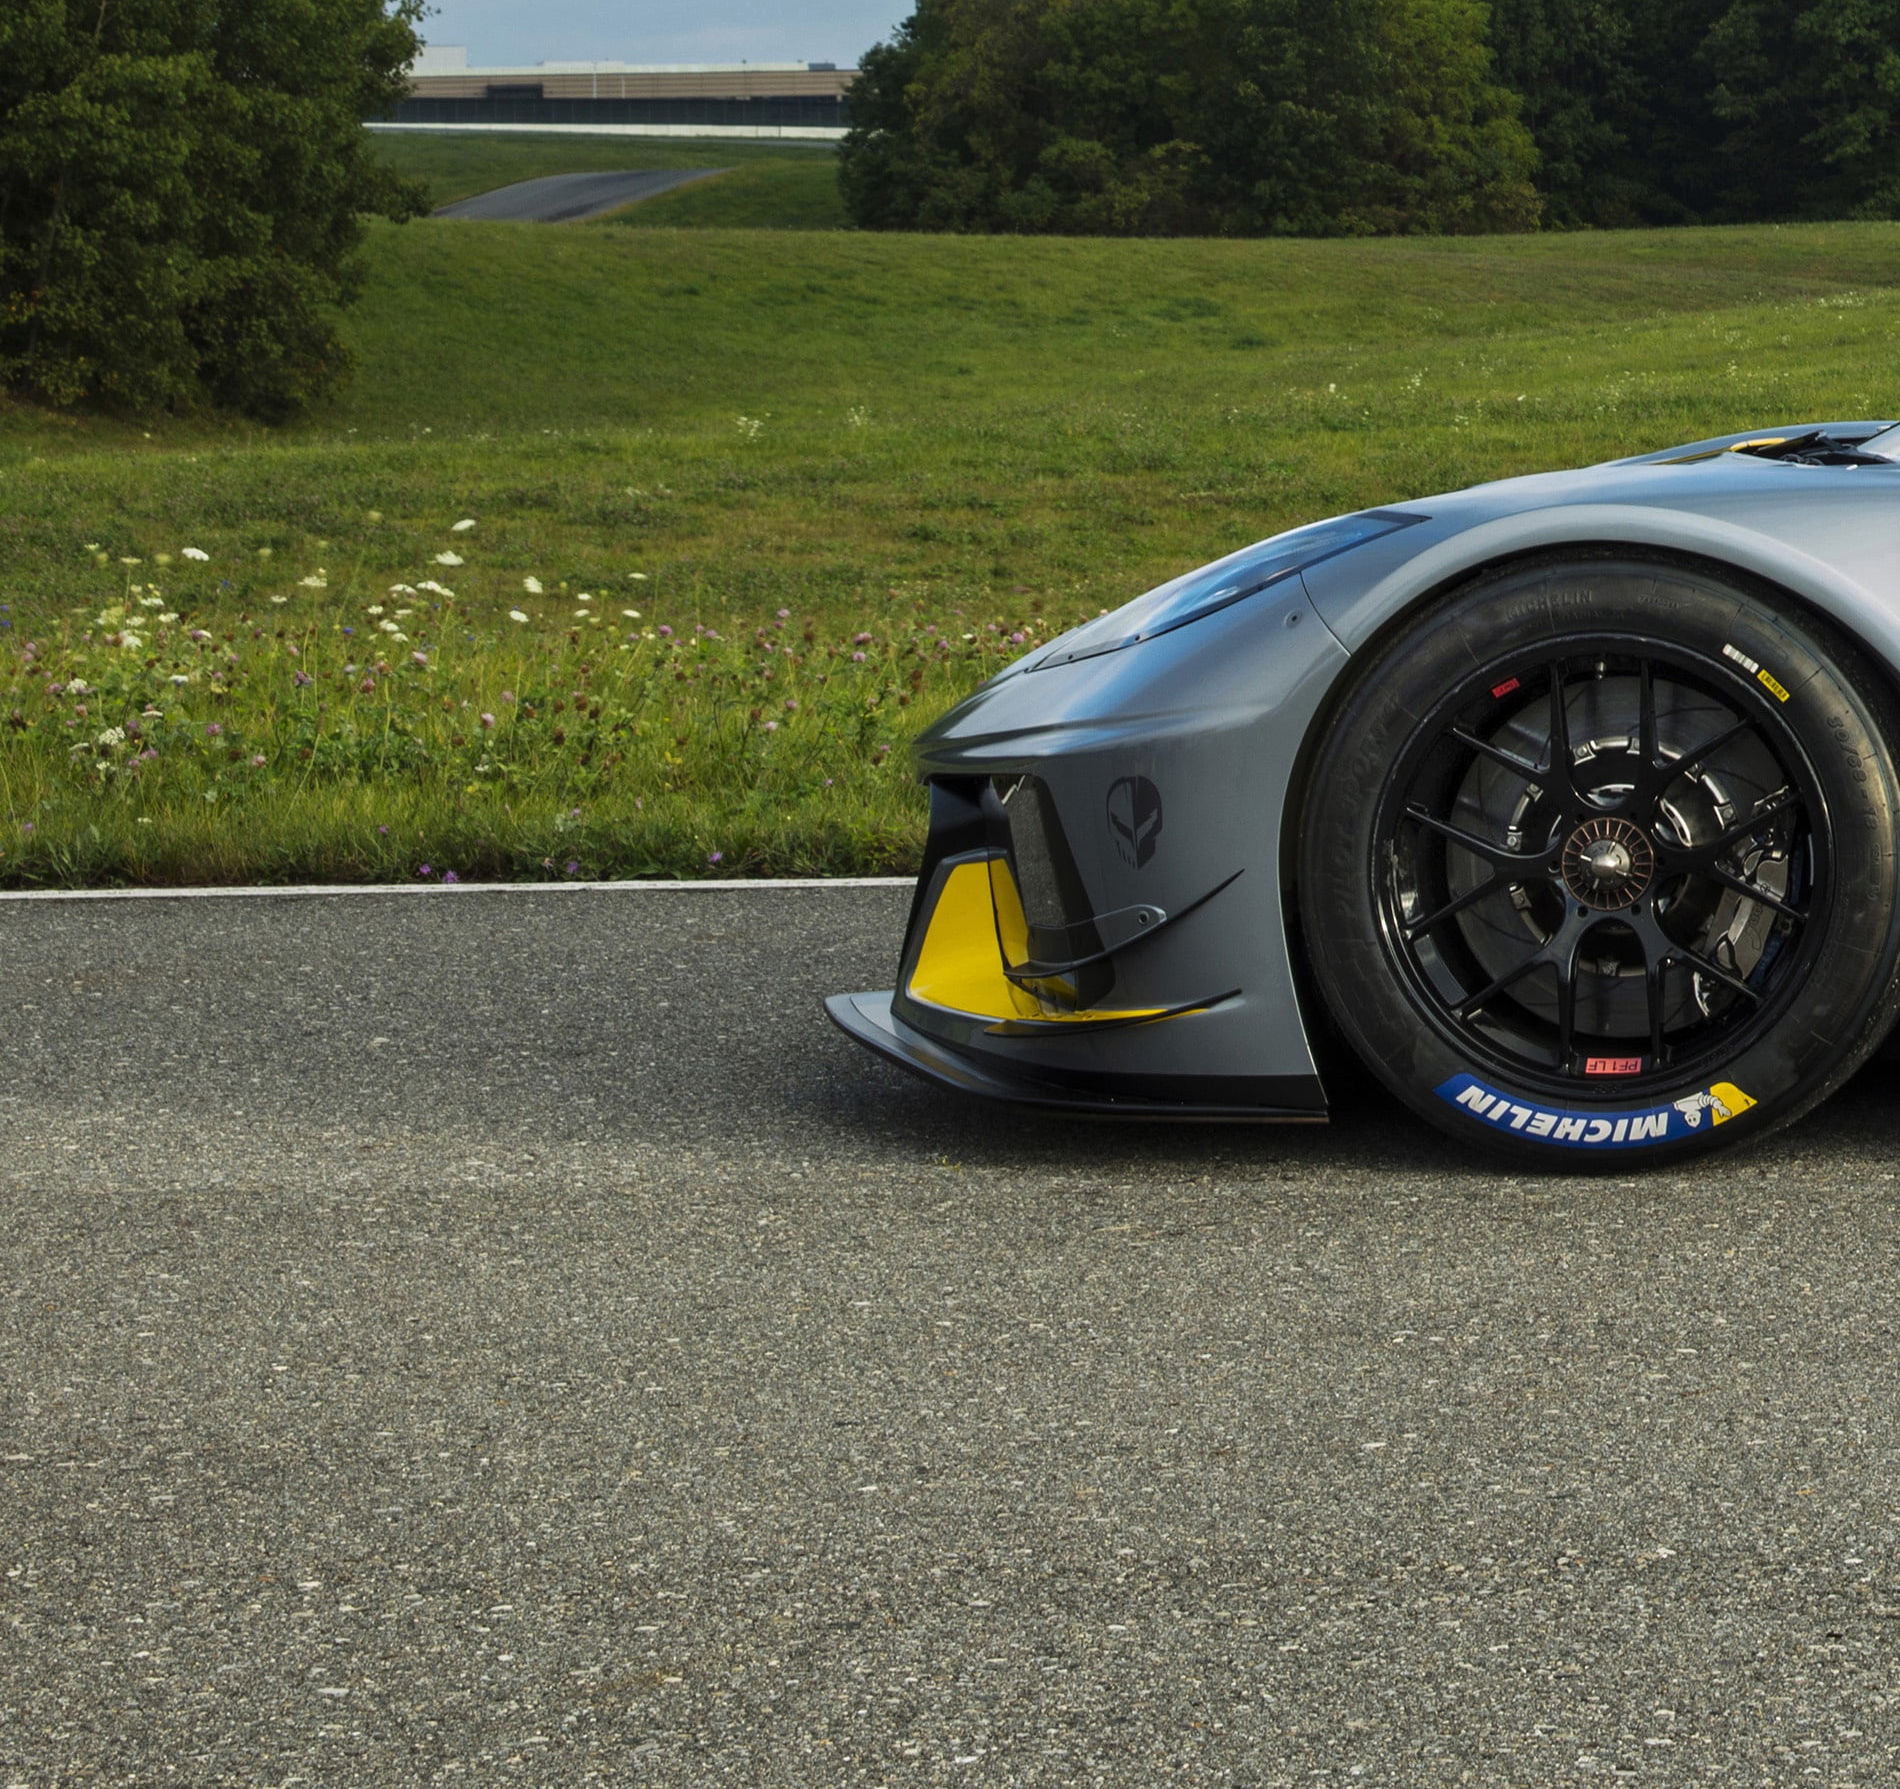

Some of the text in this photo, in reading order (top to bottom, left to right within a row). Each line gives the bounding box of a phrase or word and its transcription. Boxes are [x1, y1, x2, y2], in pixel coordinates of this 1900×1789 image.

[1588, 1060, 1638, 1072] PF1 LF
[1456, 1085, 1669, 1142] MICHELIN
